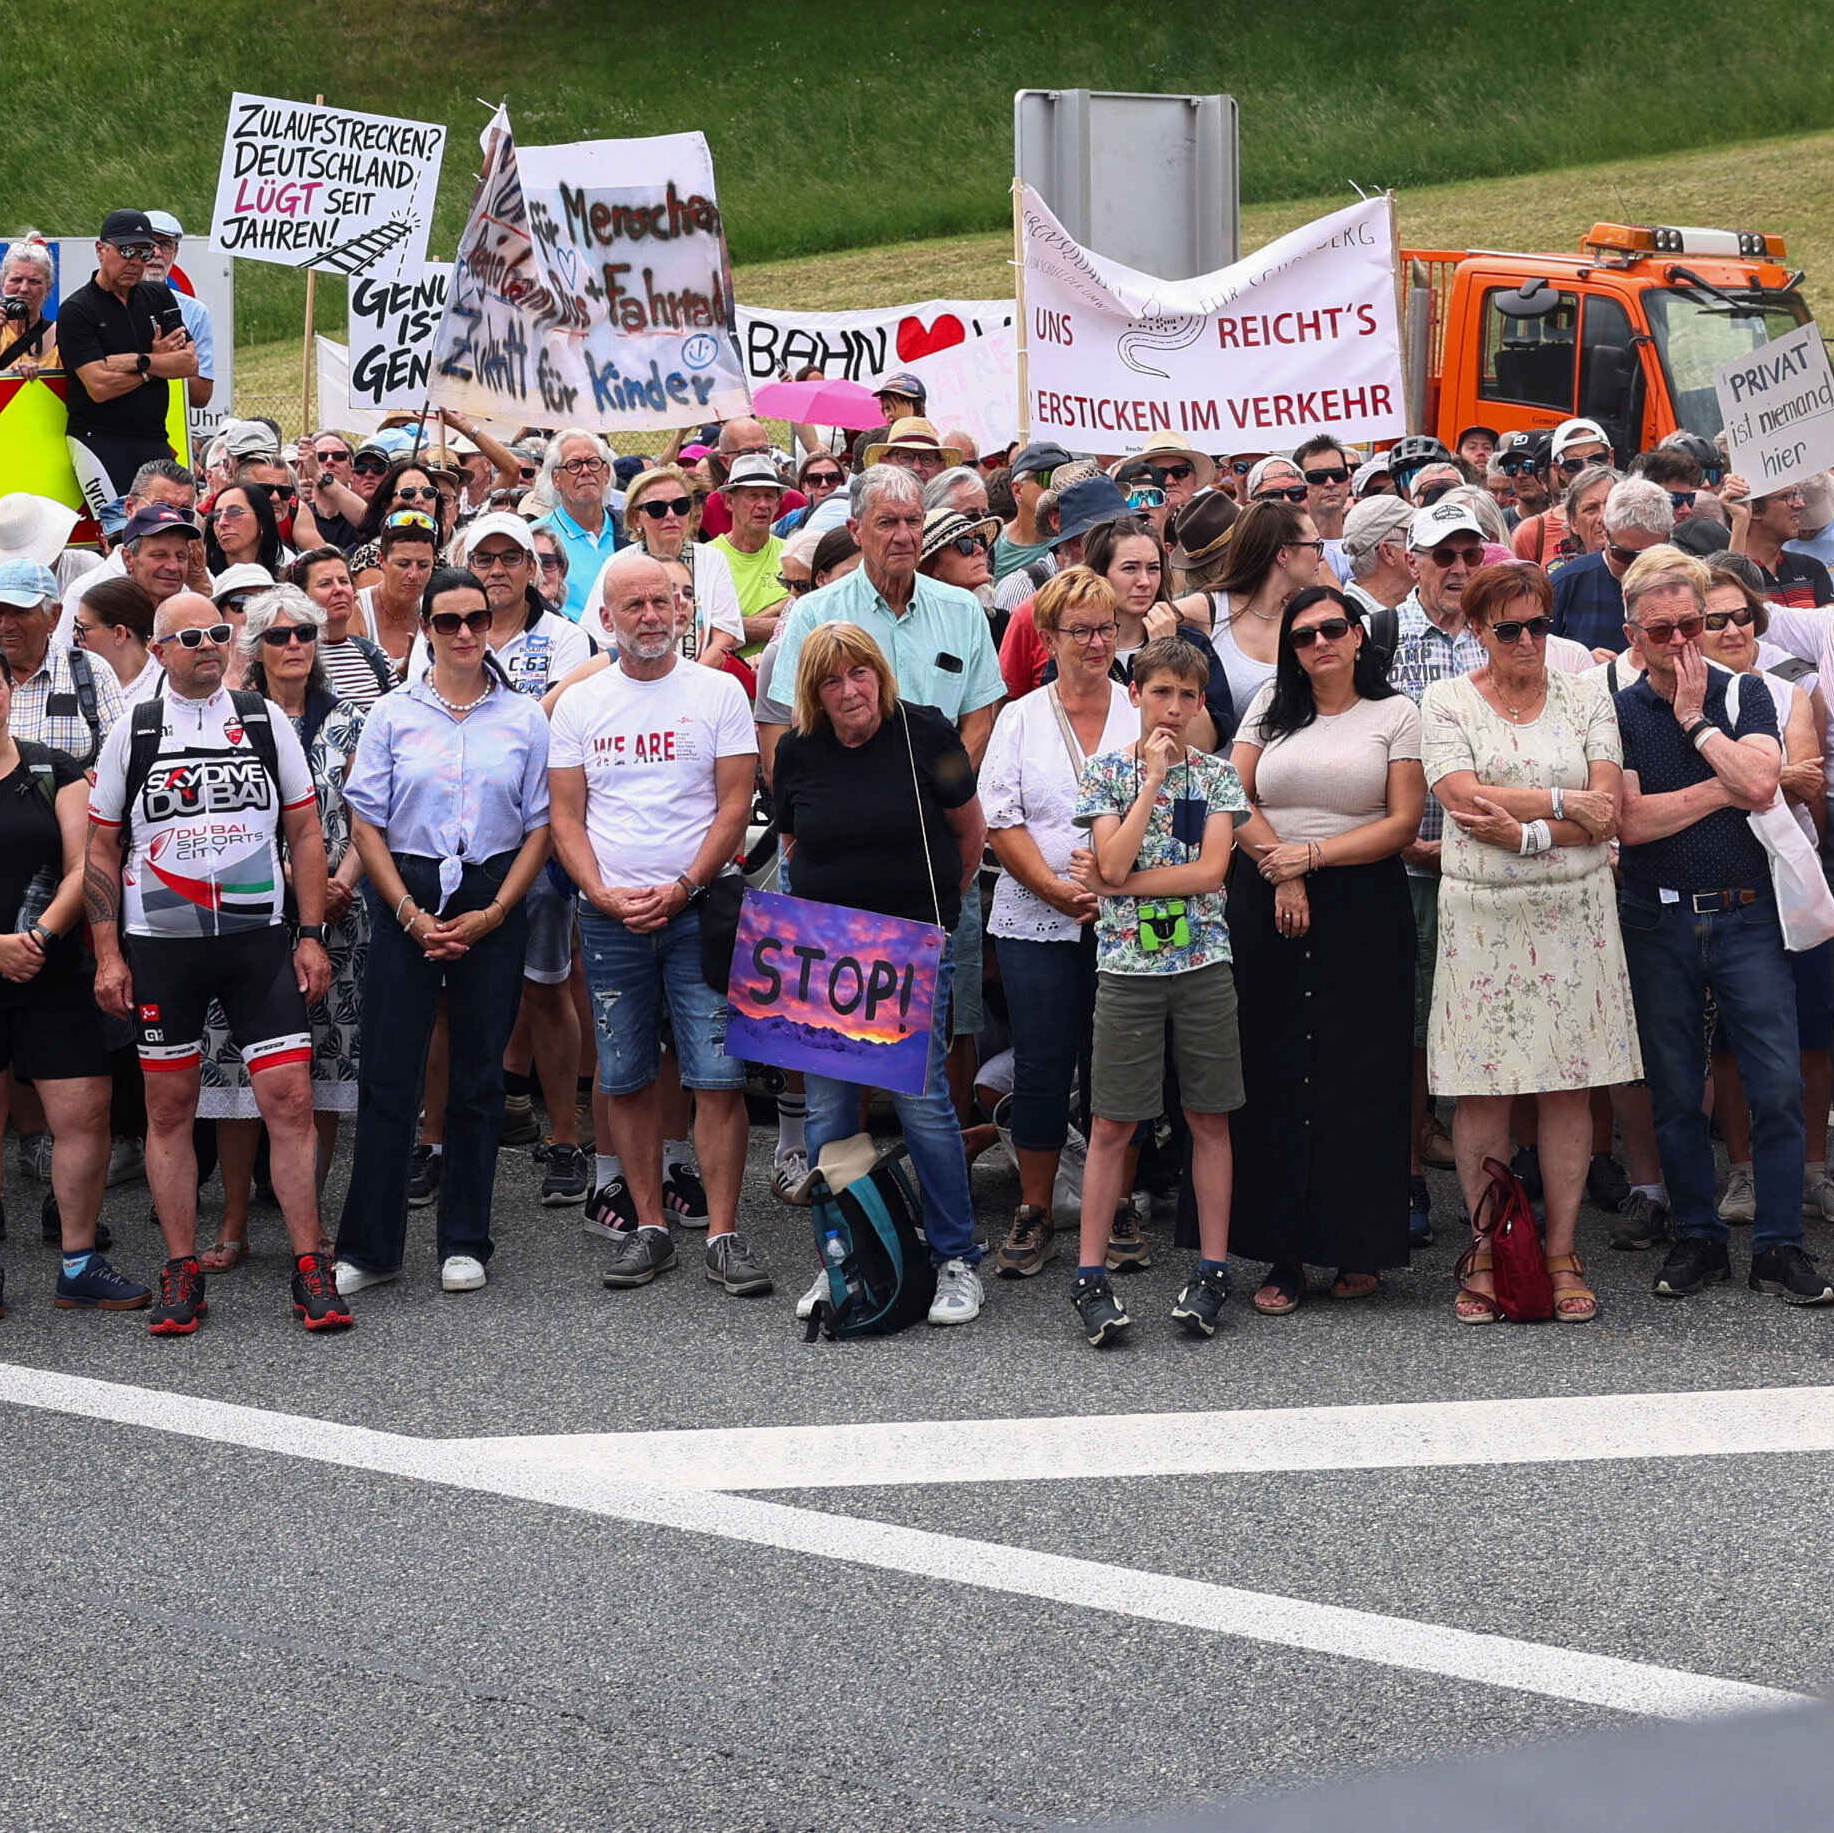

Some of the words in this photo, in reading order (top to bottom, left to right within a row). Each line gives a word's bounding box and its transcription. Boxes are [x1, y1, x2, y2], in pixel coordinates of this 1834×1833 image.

[232, 104, 442, 162] ZULAUFSTRECKEN?
[233, 141, 415, 189] DEUTSCHLAND
[234, 178, 324, 218] LÜGT
[324, 188, 376, 216] SEIT
[220, 216, 340, 251] JAHREN!
[1035, 306, 1075, 346] UNS
[748, 320, 887, 382] BAHN
[352, 344, 432, 404] GEN
[1038, 389, 1171, 432] ERSTICKEN
[1180, 400, 1220, 431] IM
[1227, 383, 1393, 430] VERKEHR
[1730, 412, 1753, 448] ist
[1758, 370, 1834, 434] niemand
[1760, 440, 1807, 479] hier
[1393, 647, 1433, 664] AMP
[633, 731, 676, 765] ARE
[146, 763, 265, 794] SKYDIVE
[146, 781, 267, 817] DUBAI
[176, 824, 247, 840] DUBAI
[176, 831, 264, 851] SPORTS
[176, 846, 226, 861] CITY
[748, 937, 915, 1034] STOP!
